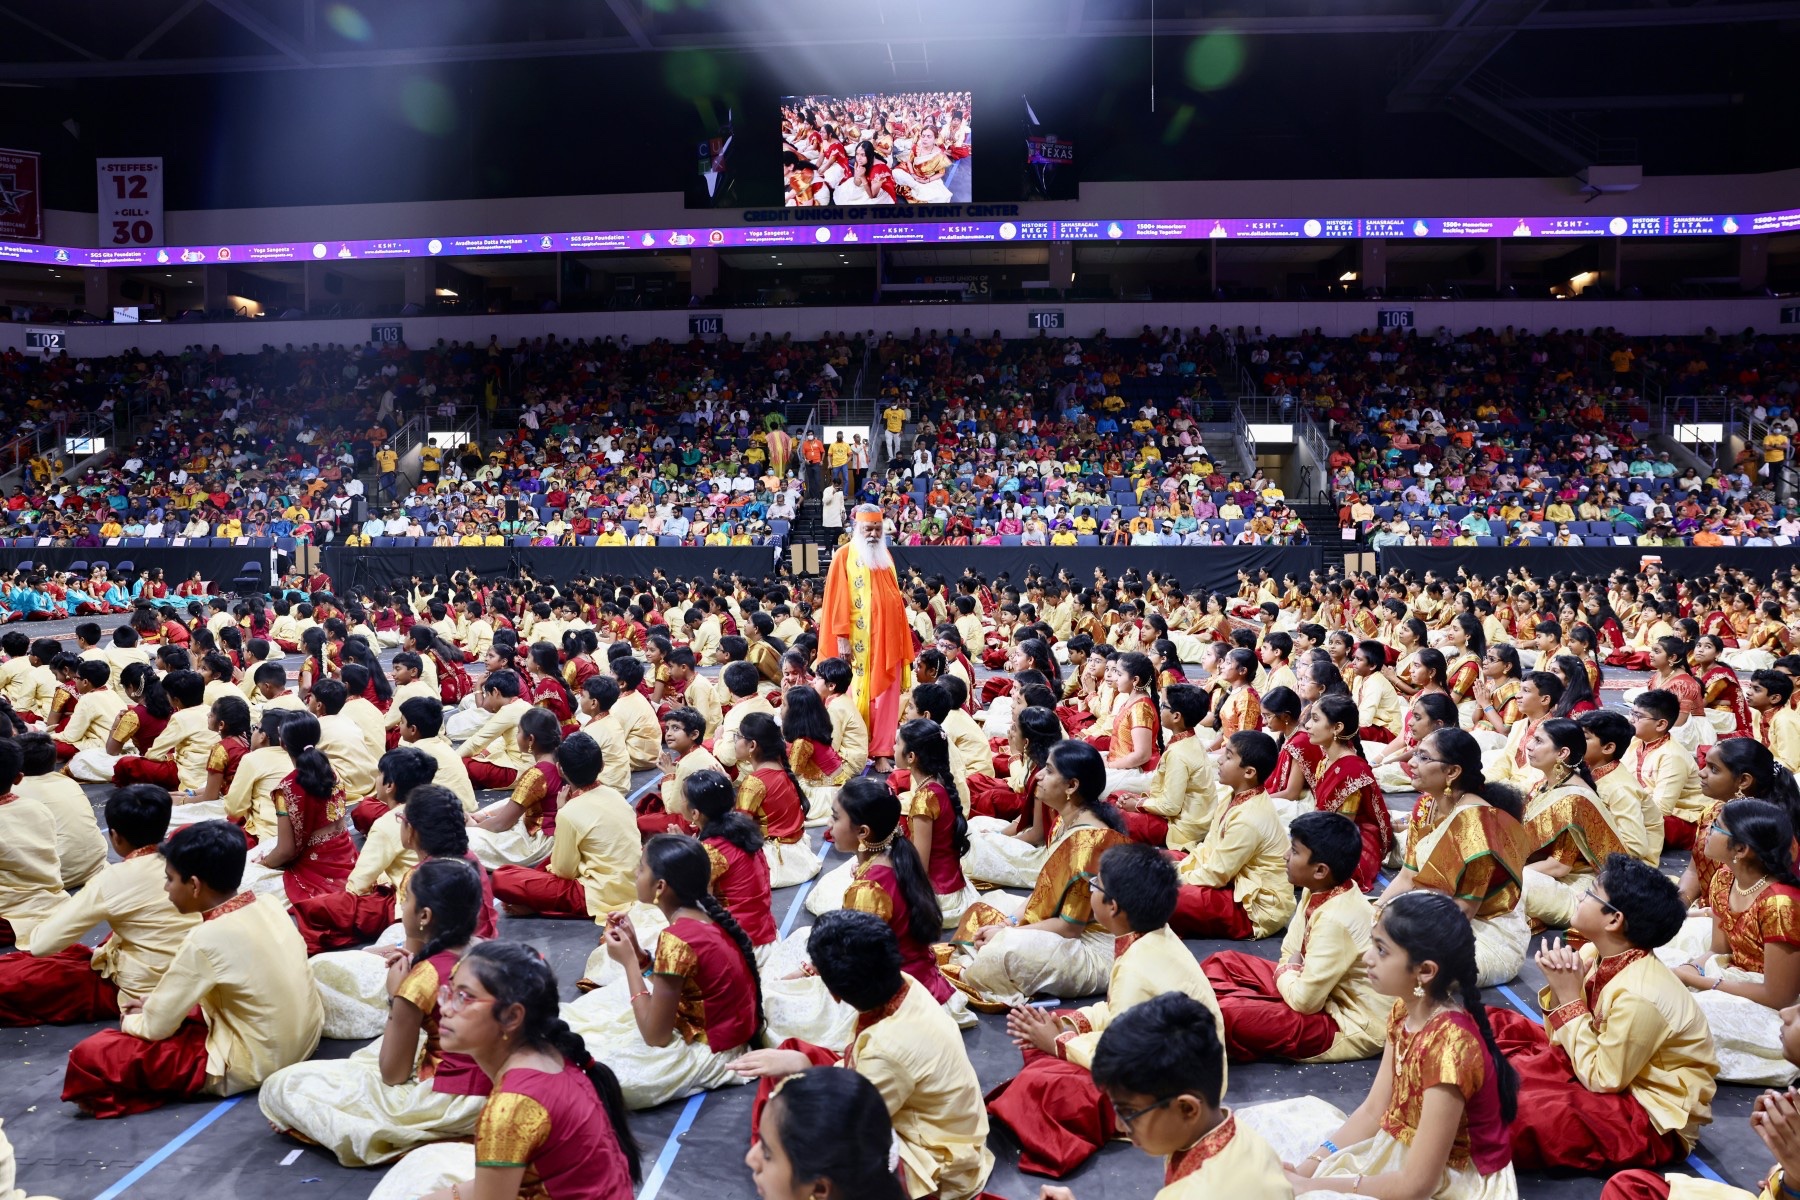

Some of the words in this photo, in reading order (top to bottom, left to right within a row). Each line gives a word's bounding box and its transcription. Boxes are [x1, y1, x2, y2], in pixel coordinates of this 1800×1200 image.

[1041, 147, 1073, 160] TEXAS
[107, 164, 153, 172] STEFFES
[113, 175, 147, 199] 12
[121, 208, 143, 217] GILL
[743, 210, 790, 222] CREDIT
[795, 208, 843, 221] UNION
[848, 208, 867, 220] OF
[871, 206, 914, 219] TEXAS
[918, 205, 962, 218] EVENT
[967, 205, 1019, 217] CENTER
[113, 220, 153, 244] 30
[695, 319, 717, 333] 104
[1035, 314, 1058, 328] 105
[1384, 312, 1408, 326] 106
[34, 333, 59, 348] 102
[377, 327, 398, 341] 103
